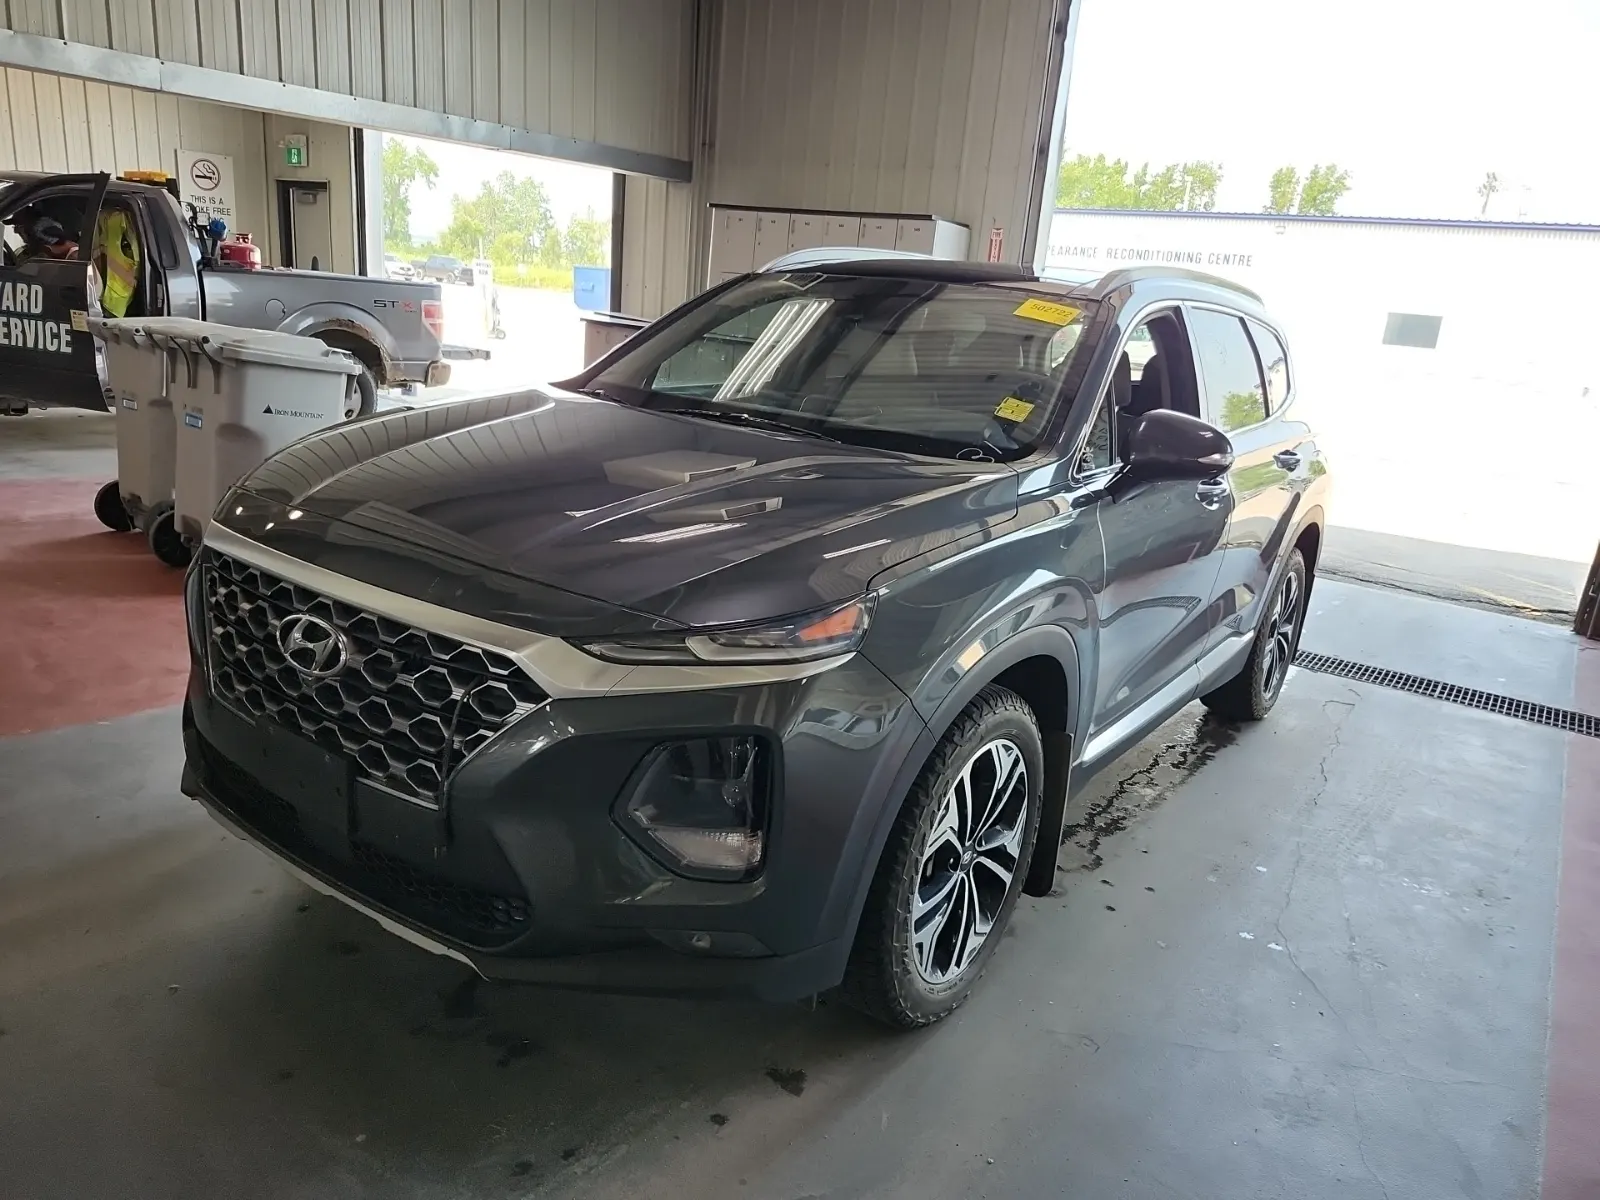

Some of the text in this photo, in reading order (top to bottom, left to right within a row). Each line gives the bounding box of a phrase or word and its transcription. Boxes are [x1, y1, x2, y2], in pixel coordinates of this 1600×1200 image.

[190, 195, 206, 203] THIS
[185, 204, 231, 216] SOKE FREE
[1106, 247, 1202, 264] RECONDITIONING
[1207, 252, 1253, 267] CENTRE
[0, 281, 43, 314] ARD
[274, 408, 323, 419] IRON MOUNTAIN
